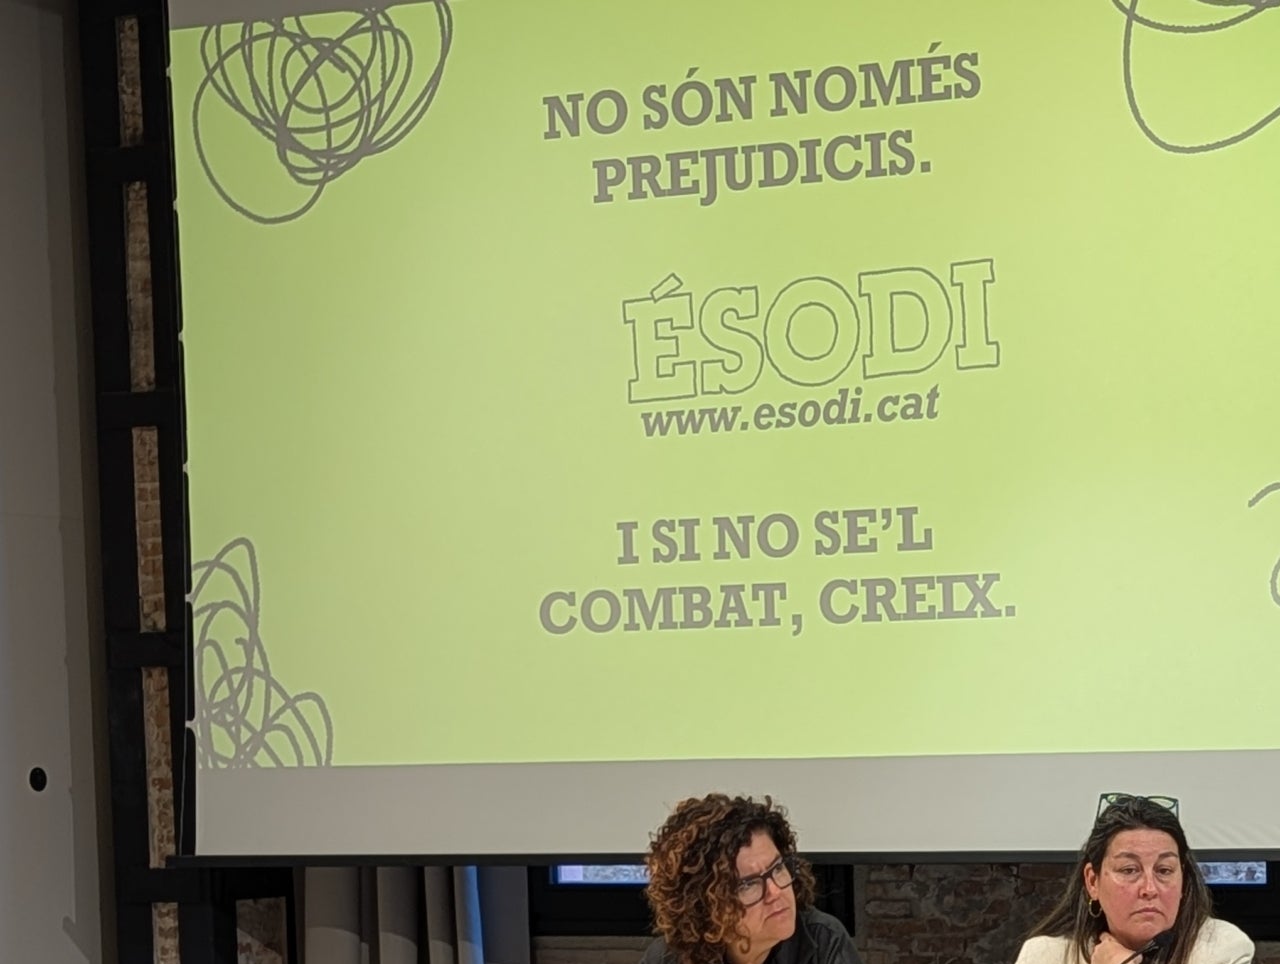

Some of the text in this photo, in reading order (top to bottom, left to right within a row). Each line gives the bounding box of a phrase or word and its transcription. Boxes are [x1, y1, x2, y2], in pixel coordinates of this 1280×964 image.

[543, 41, 981, 140] NO SÓN NOMÉS
[592, 129, 931, 206] PREJUDICIS.
[622, 258, 1000, 404] ÉSODI
[641, 384, 939, 437] www.esodi.cat
[616, 506, 933, 565] I SI NO SE'L
[539, 573, 1016, 637] COMBAT, CREIX.
